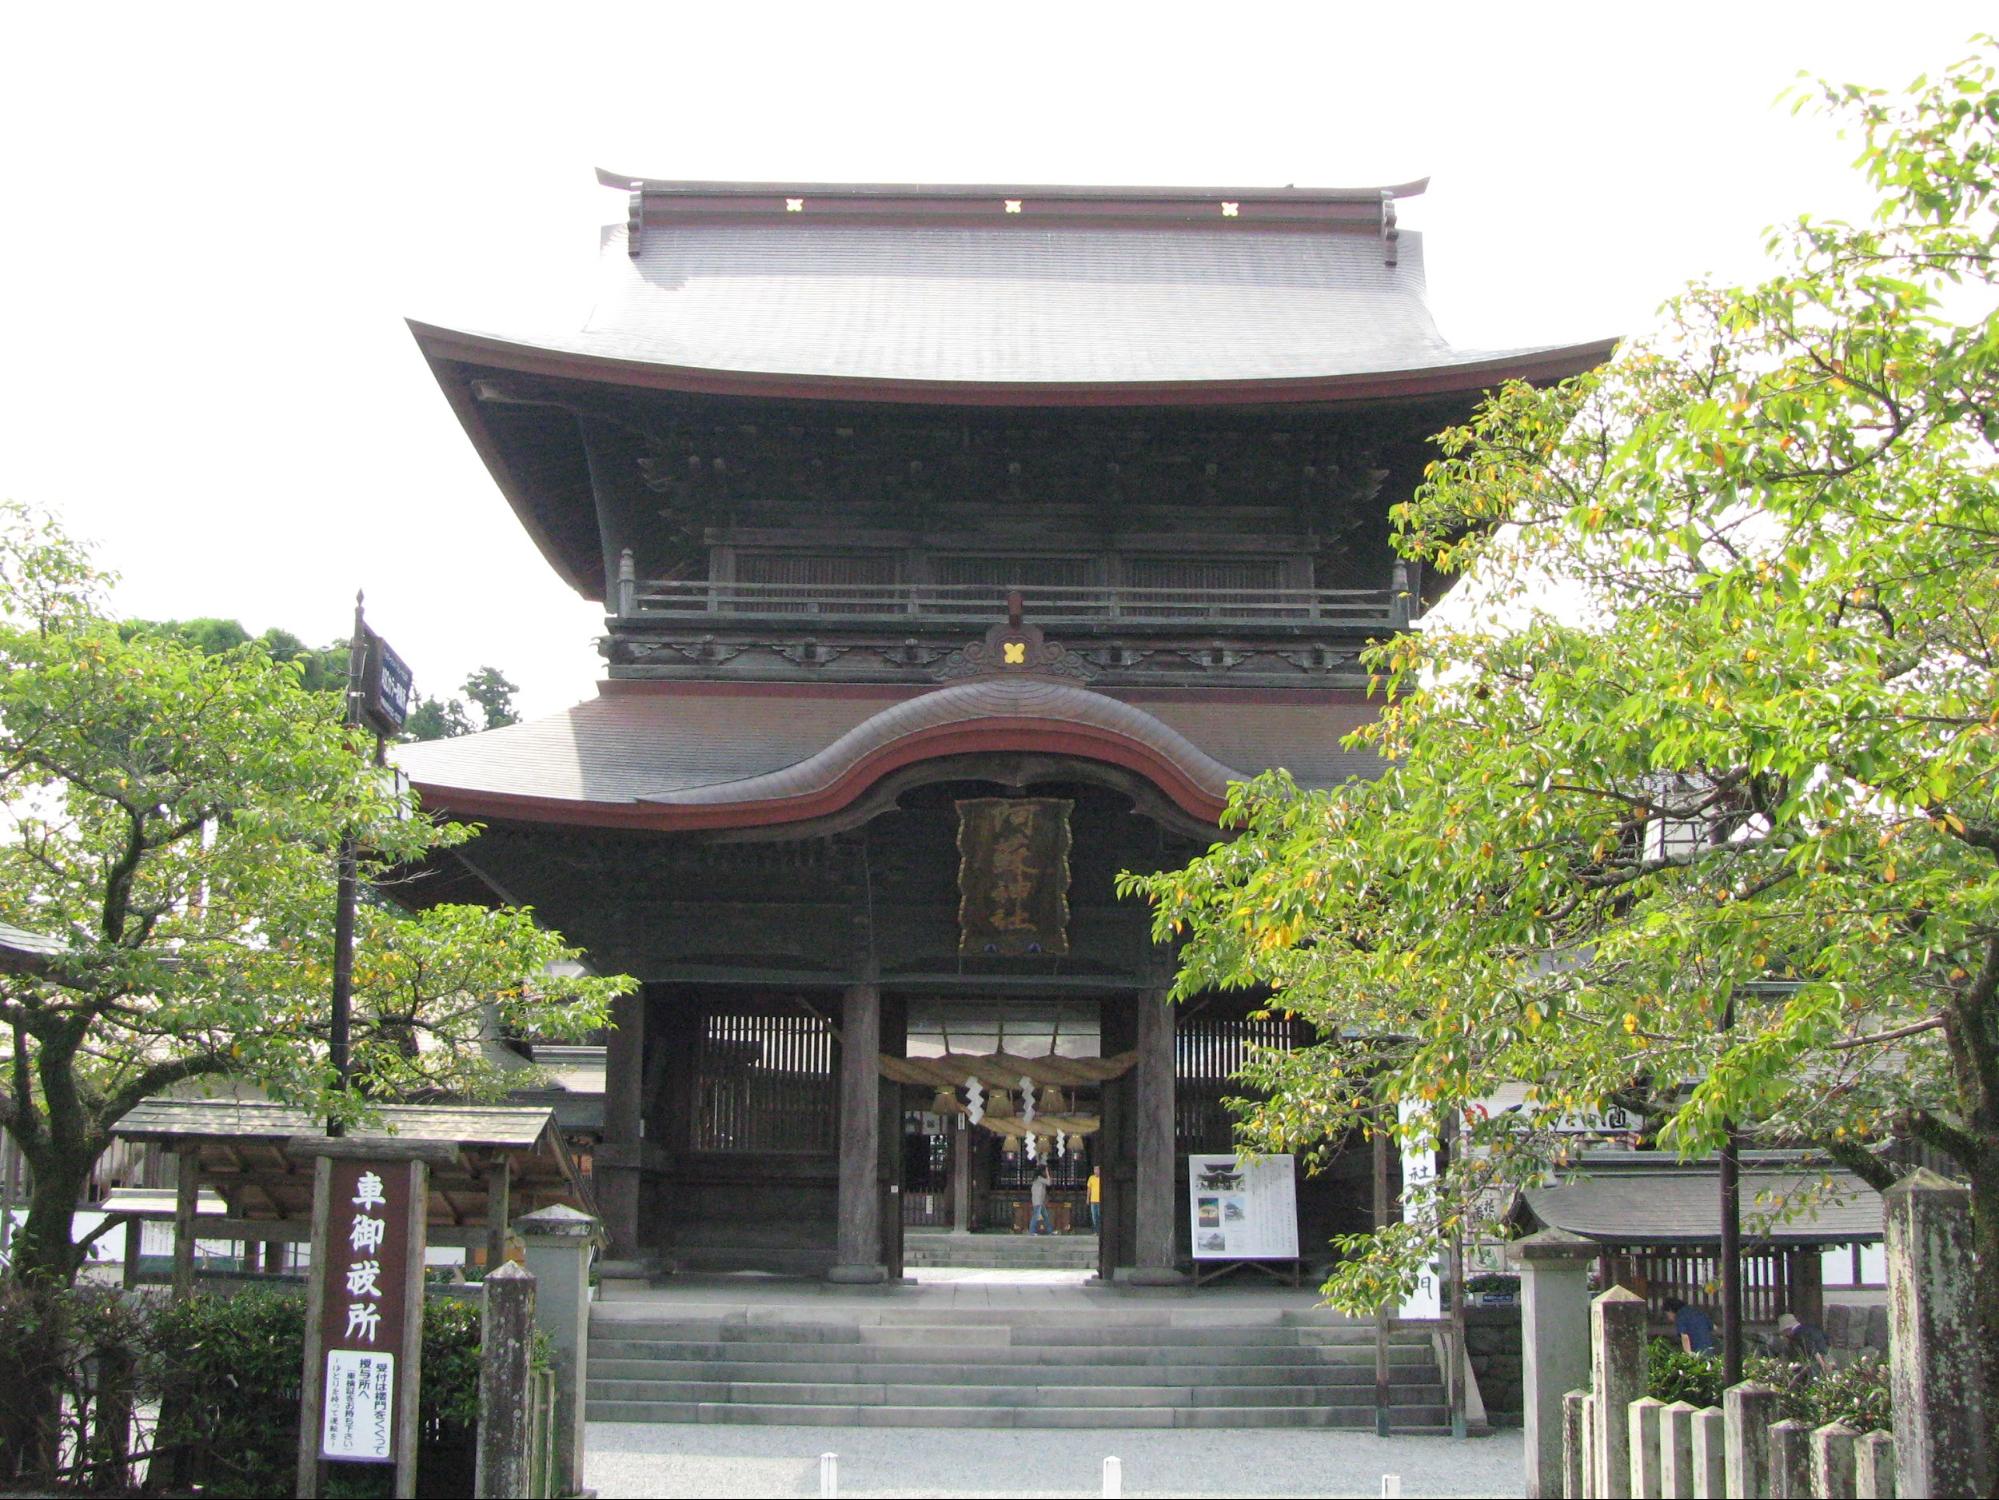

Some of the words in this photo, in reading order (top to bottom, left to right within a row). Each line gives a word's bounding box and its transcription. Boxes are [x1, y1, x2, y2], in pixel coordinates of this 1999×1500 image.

[344, 1171, 387, 1343] 車御祓所
[358, 1358, 372, 1400] 授与所へ
